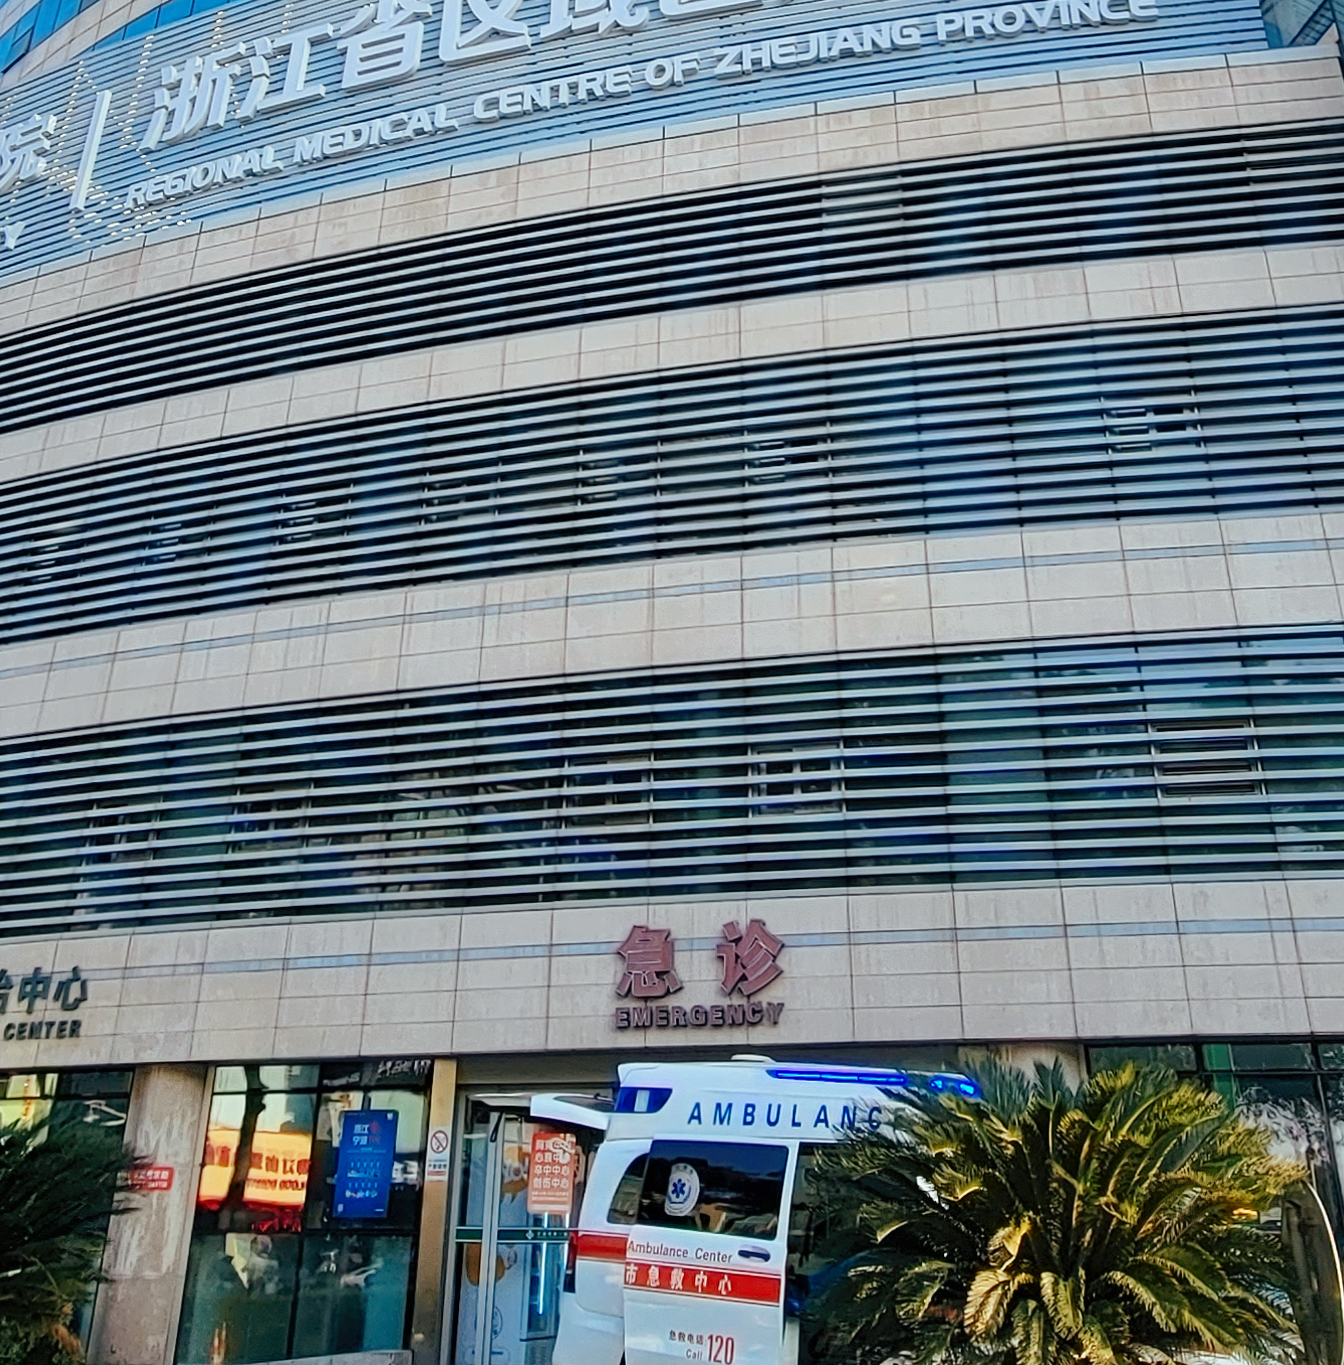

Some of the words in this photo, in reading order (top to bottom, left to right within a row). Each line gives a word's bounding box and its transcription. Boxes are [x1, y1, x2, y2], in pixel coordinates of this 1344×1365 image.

[124, 147, 285, 211] REGIONAL
[293, 104, 459, 166] MEDICAL
[473, 64, 633, 123] CENTRE
[644, 51, 699, 89] OF
[714, 17, 923, 80] ZHEJIANG
[615, 918, 785, 998] 急诊
[3, 1019, 83, 1041] CENTER
[615, 1001, 786, 1030] EMERGENCY
[687, 1101, 884, 1130] AMBULANC
[627, 1240, 688, 1258] Ambulance
[695, 1247, 733, 1263] Center
[625, 1263, 732, 1296] 市急救中心
[686, 1348, 703, 1362] Call
[707, 1334, 735, 1365] 120
